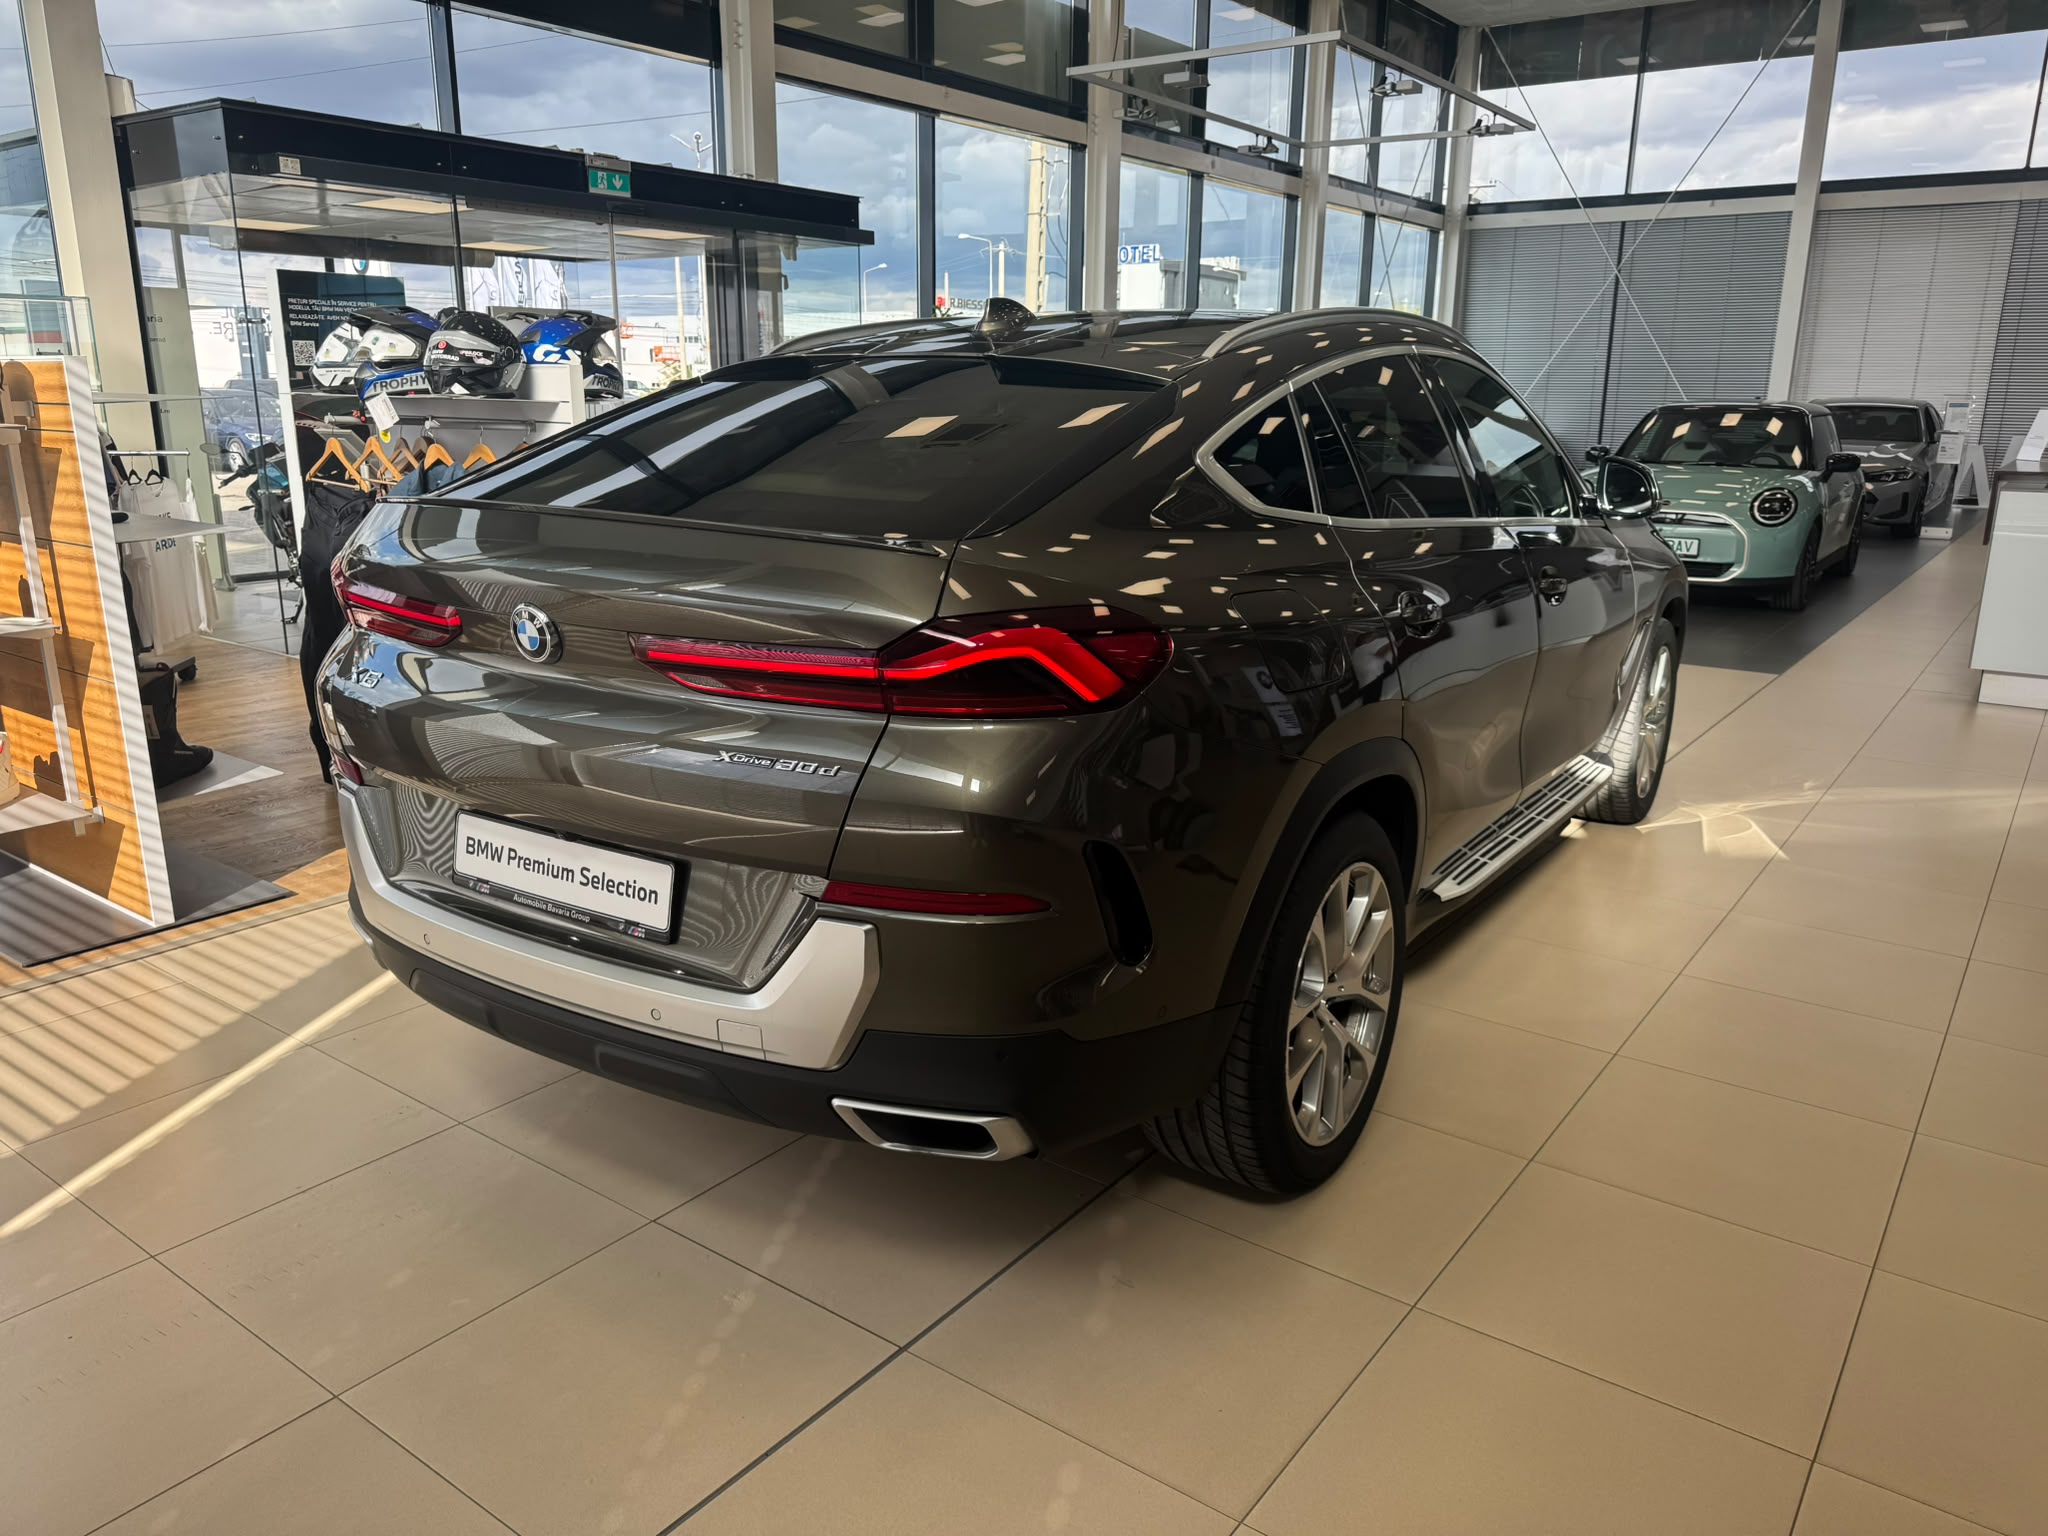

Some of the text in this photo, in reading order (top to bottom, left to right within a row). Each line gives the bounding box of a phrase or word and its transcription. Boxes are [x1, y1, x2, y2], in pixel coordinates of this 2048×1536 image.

[1118, 245, 1161, 263] OTEL
[950, 297, 985, 310] R.BIESS
[430, 353, 460, 361] MOTORRAD
[372, 374, 428, 393] TROPHY
[512, 609, 543, 629] BMW
[351, 666, 385, 688] X6
[466, 836, 659, 905] BMW Premium Selection
[513, 894, 591, 923] Automobile Bavaria Group
